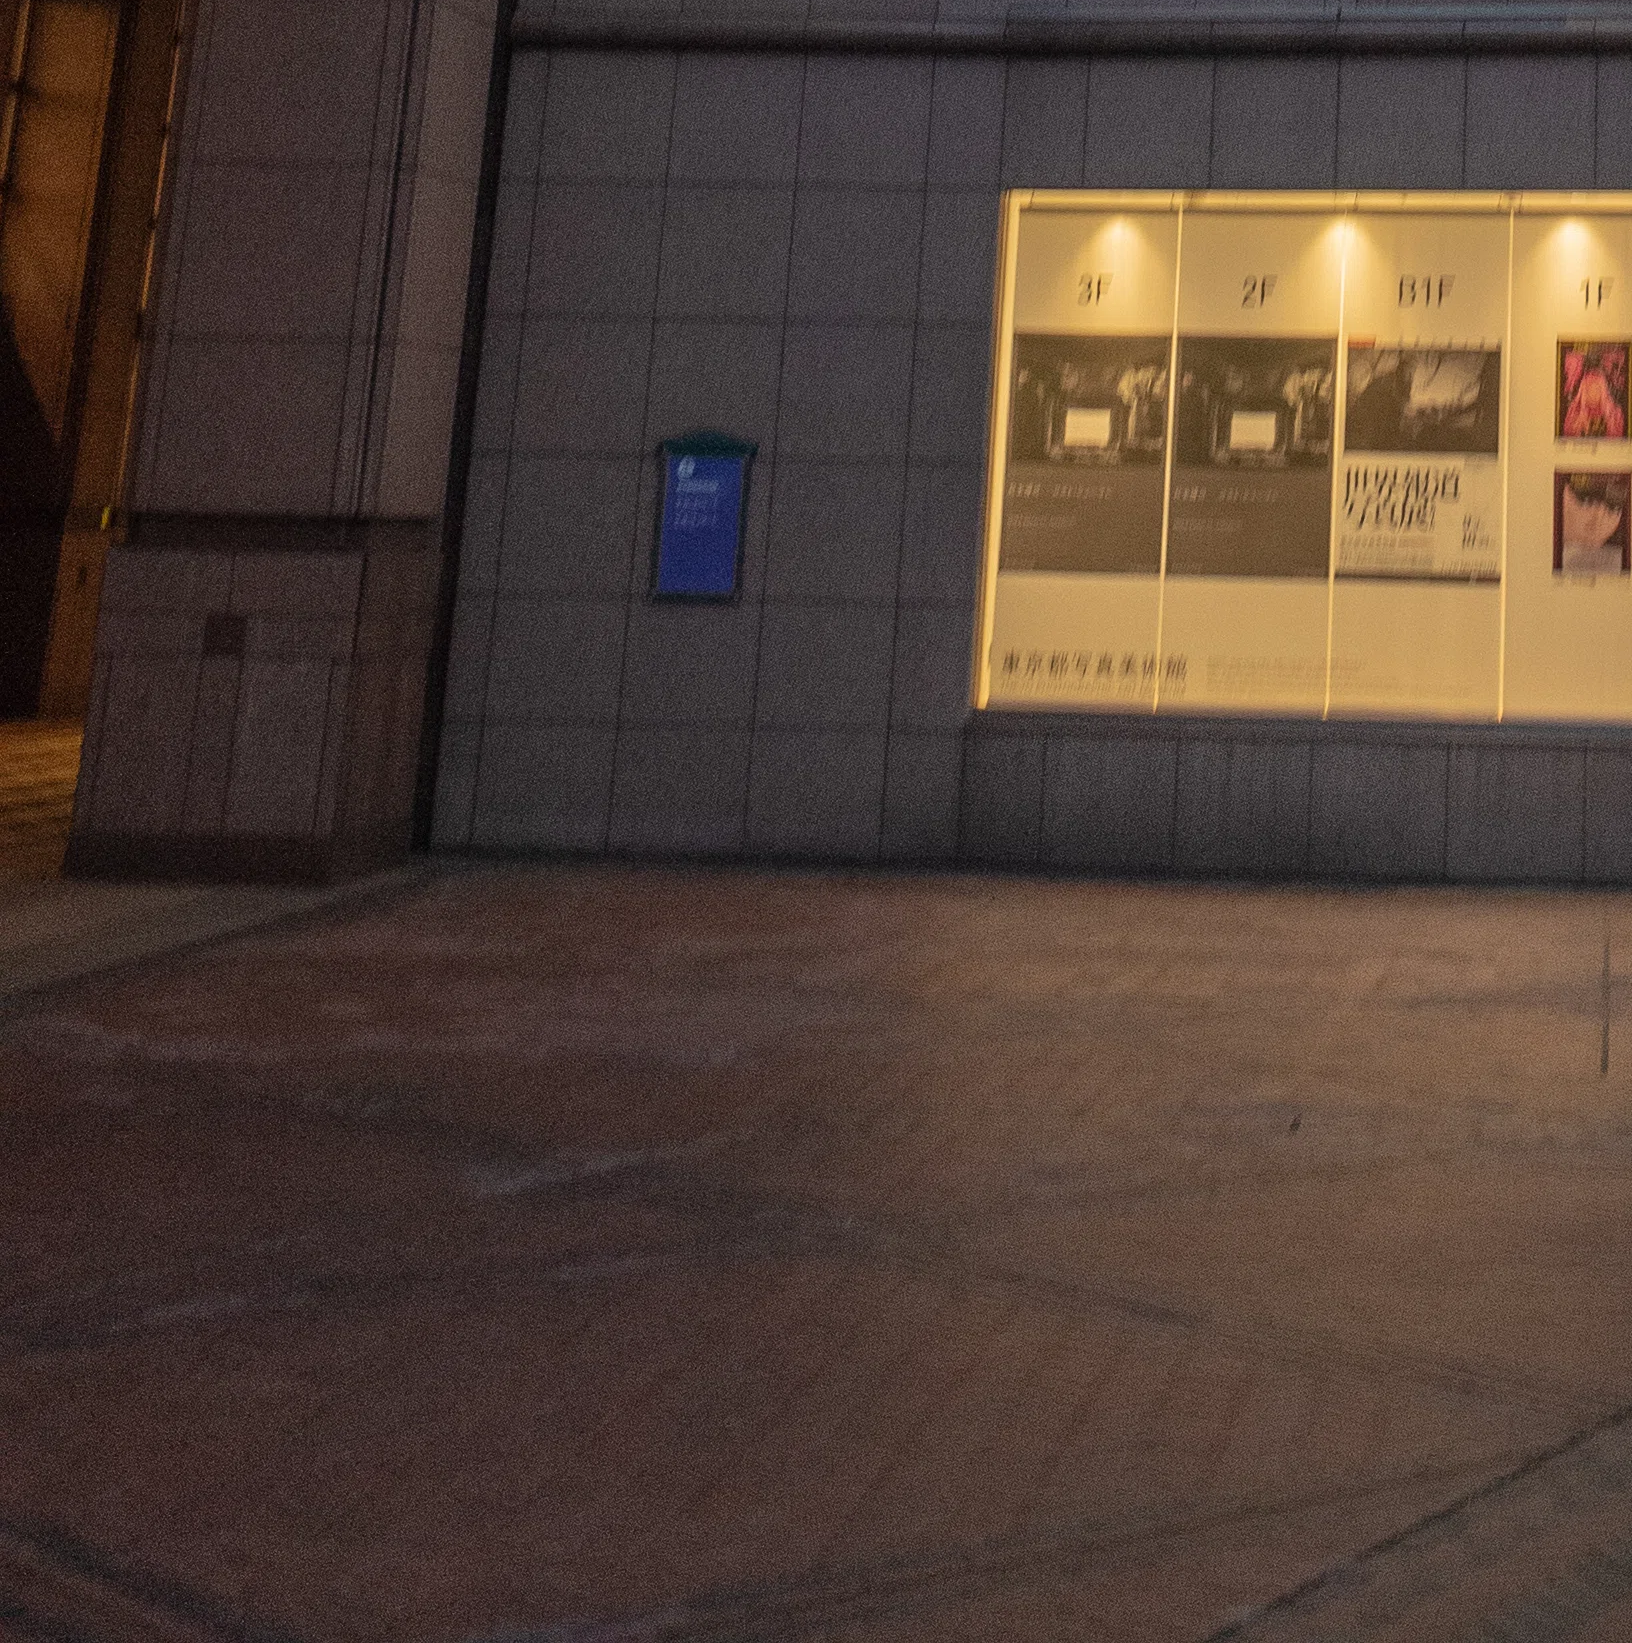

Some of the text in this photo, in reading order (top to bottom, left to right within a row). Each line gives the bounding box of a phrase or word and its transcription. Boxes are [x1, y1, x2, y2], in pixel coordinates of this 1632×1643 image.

[1077, 271, 1115, 307] 3F
[1240, 274, 1279, 310] 2F
[1398, 274, 1457, 308] B1F
[1579, 275, 1616, 311] 1F
